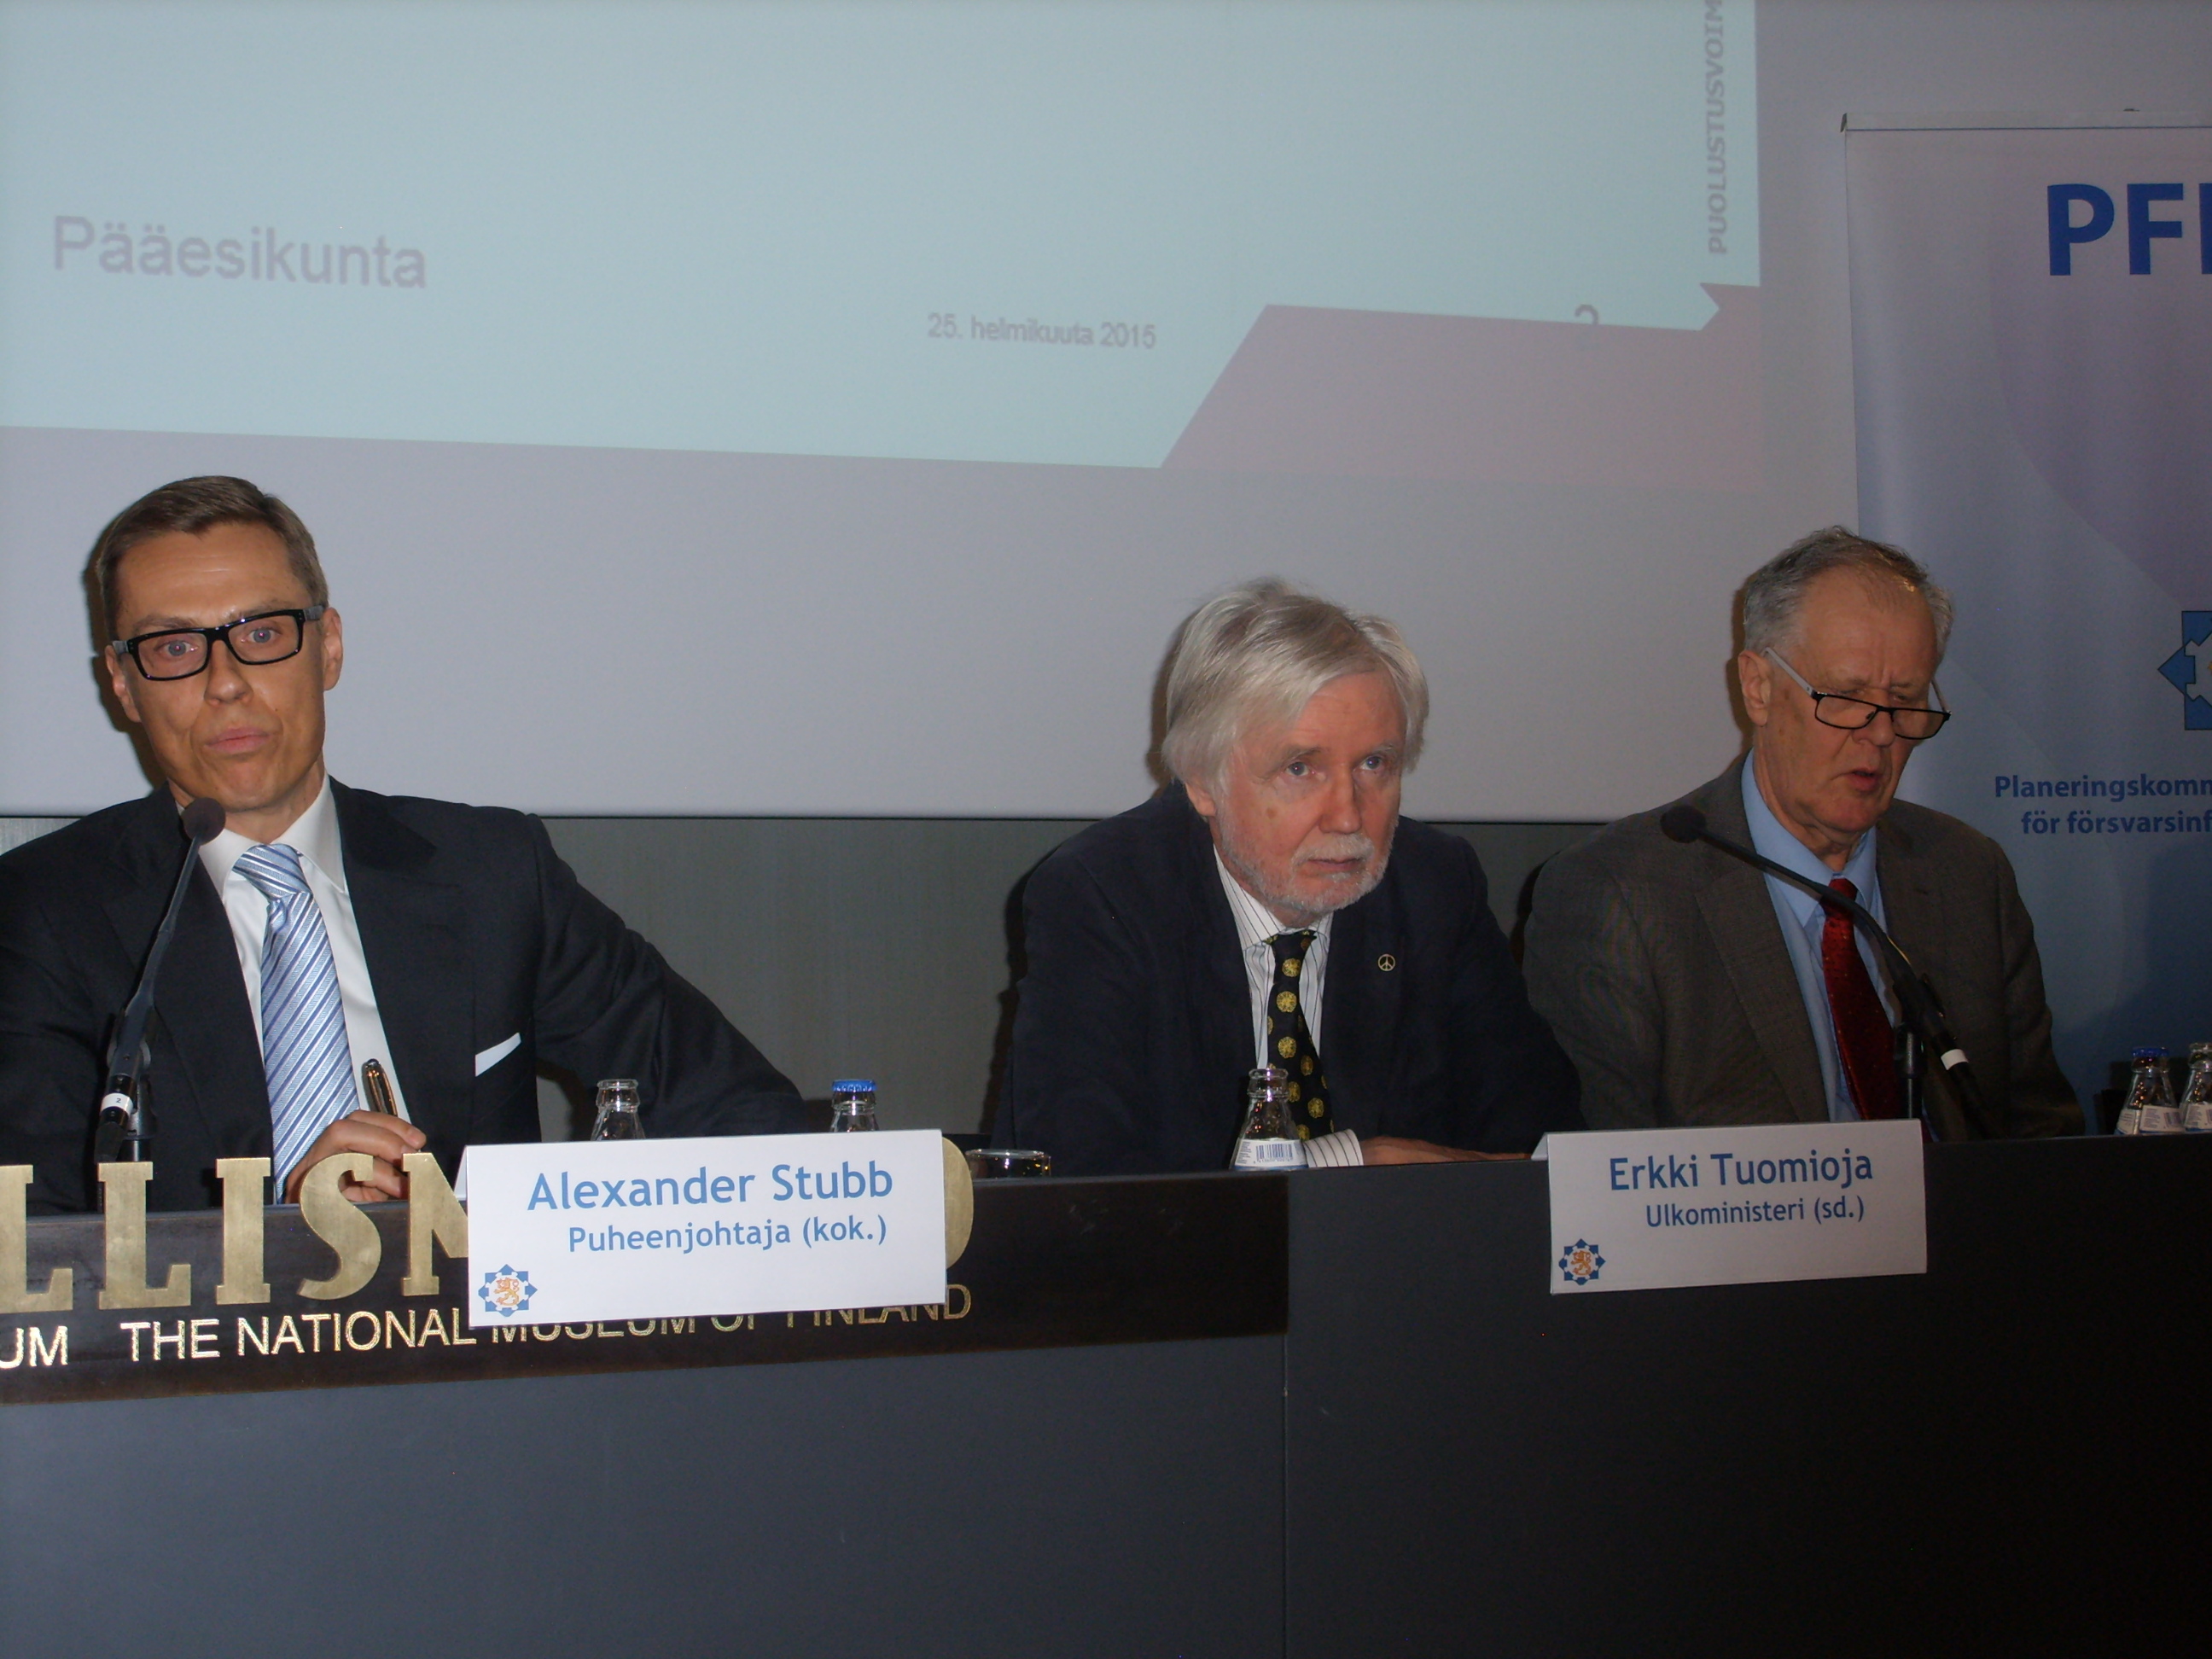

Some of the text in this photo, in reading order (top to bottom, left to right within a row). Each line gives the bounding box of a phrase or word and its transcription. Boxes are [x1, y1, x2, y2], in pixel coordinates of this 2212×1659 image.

[52, 215, 427, 289] Pääesikunta
[928, 312, 1156, 349] 25. helmikuuta 2015
[2021, 810, 2212, 834] för försvarsinf
[527, 1161, 894, 1211] Alexander Stubb
[1610, 1148, 1873, 1190] Erkki Tuomioja
[1646, 1195, 1865, 1227] Ulkoministeri (sd.)
[568, 1214, 888, 1254] Puheenjohtaja (kok.)
[120, 1318, 221, 1363] THE
[236, 1308, 477, 1357] NATIONAL
